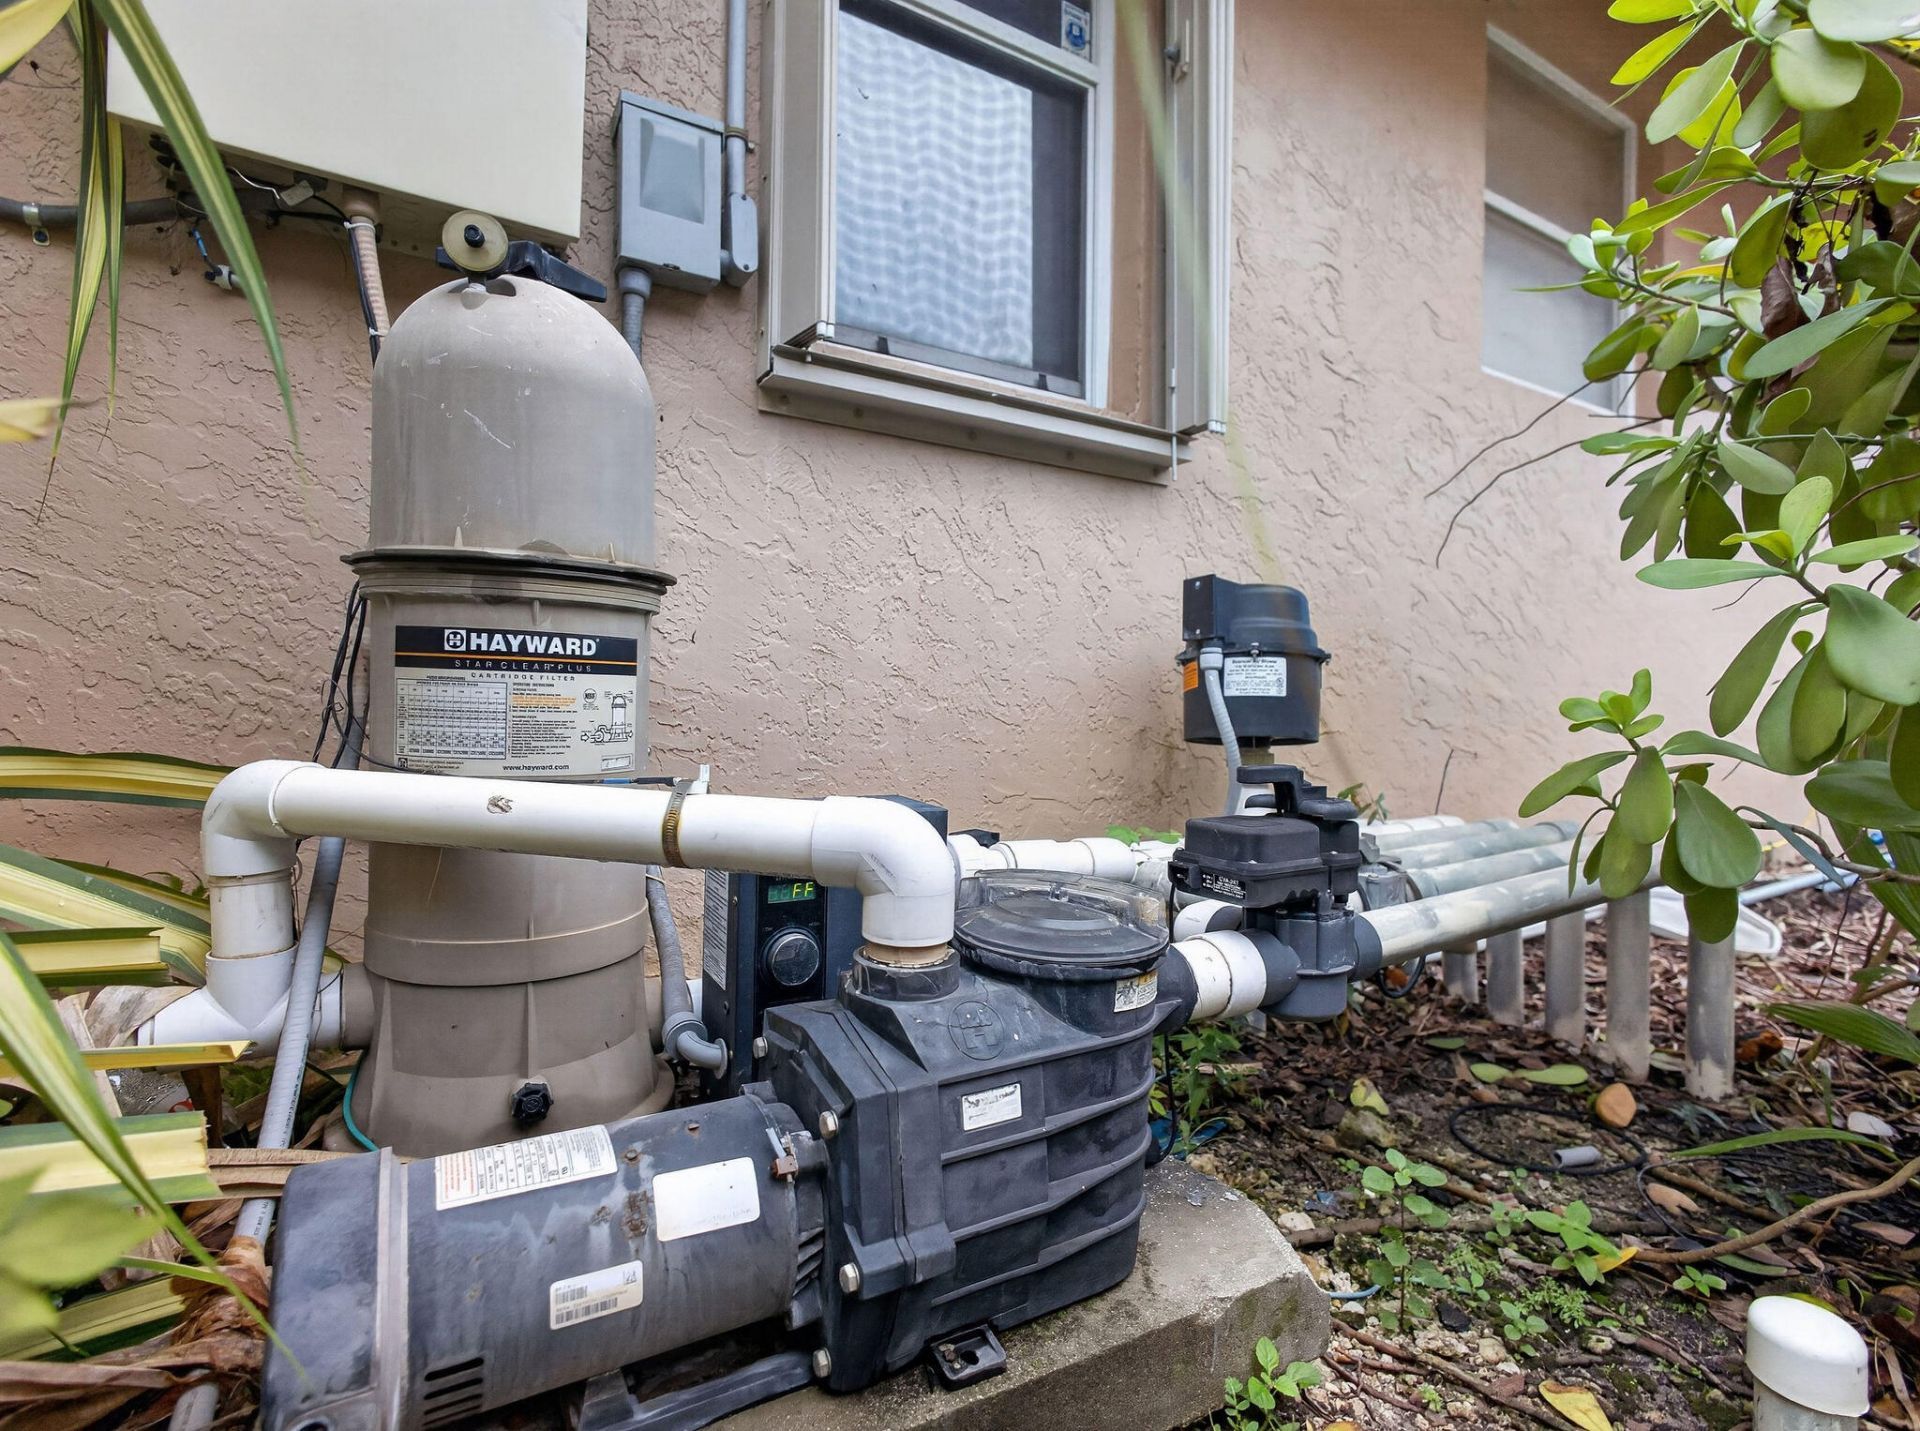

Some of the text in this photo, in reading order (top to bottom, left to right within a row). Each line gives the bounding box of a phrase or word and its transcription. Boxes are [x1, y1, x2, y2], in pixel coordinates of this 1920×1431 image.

[470, 632, 597, 656] HAYWARD
[454, 659, 493, 669] STAR
[557, 664, 592, 673] PLUS
[471, 672, 534, 680] CARTRIDGE
[502, 763, 570, 772] www.hayward.com
